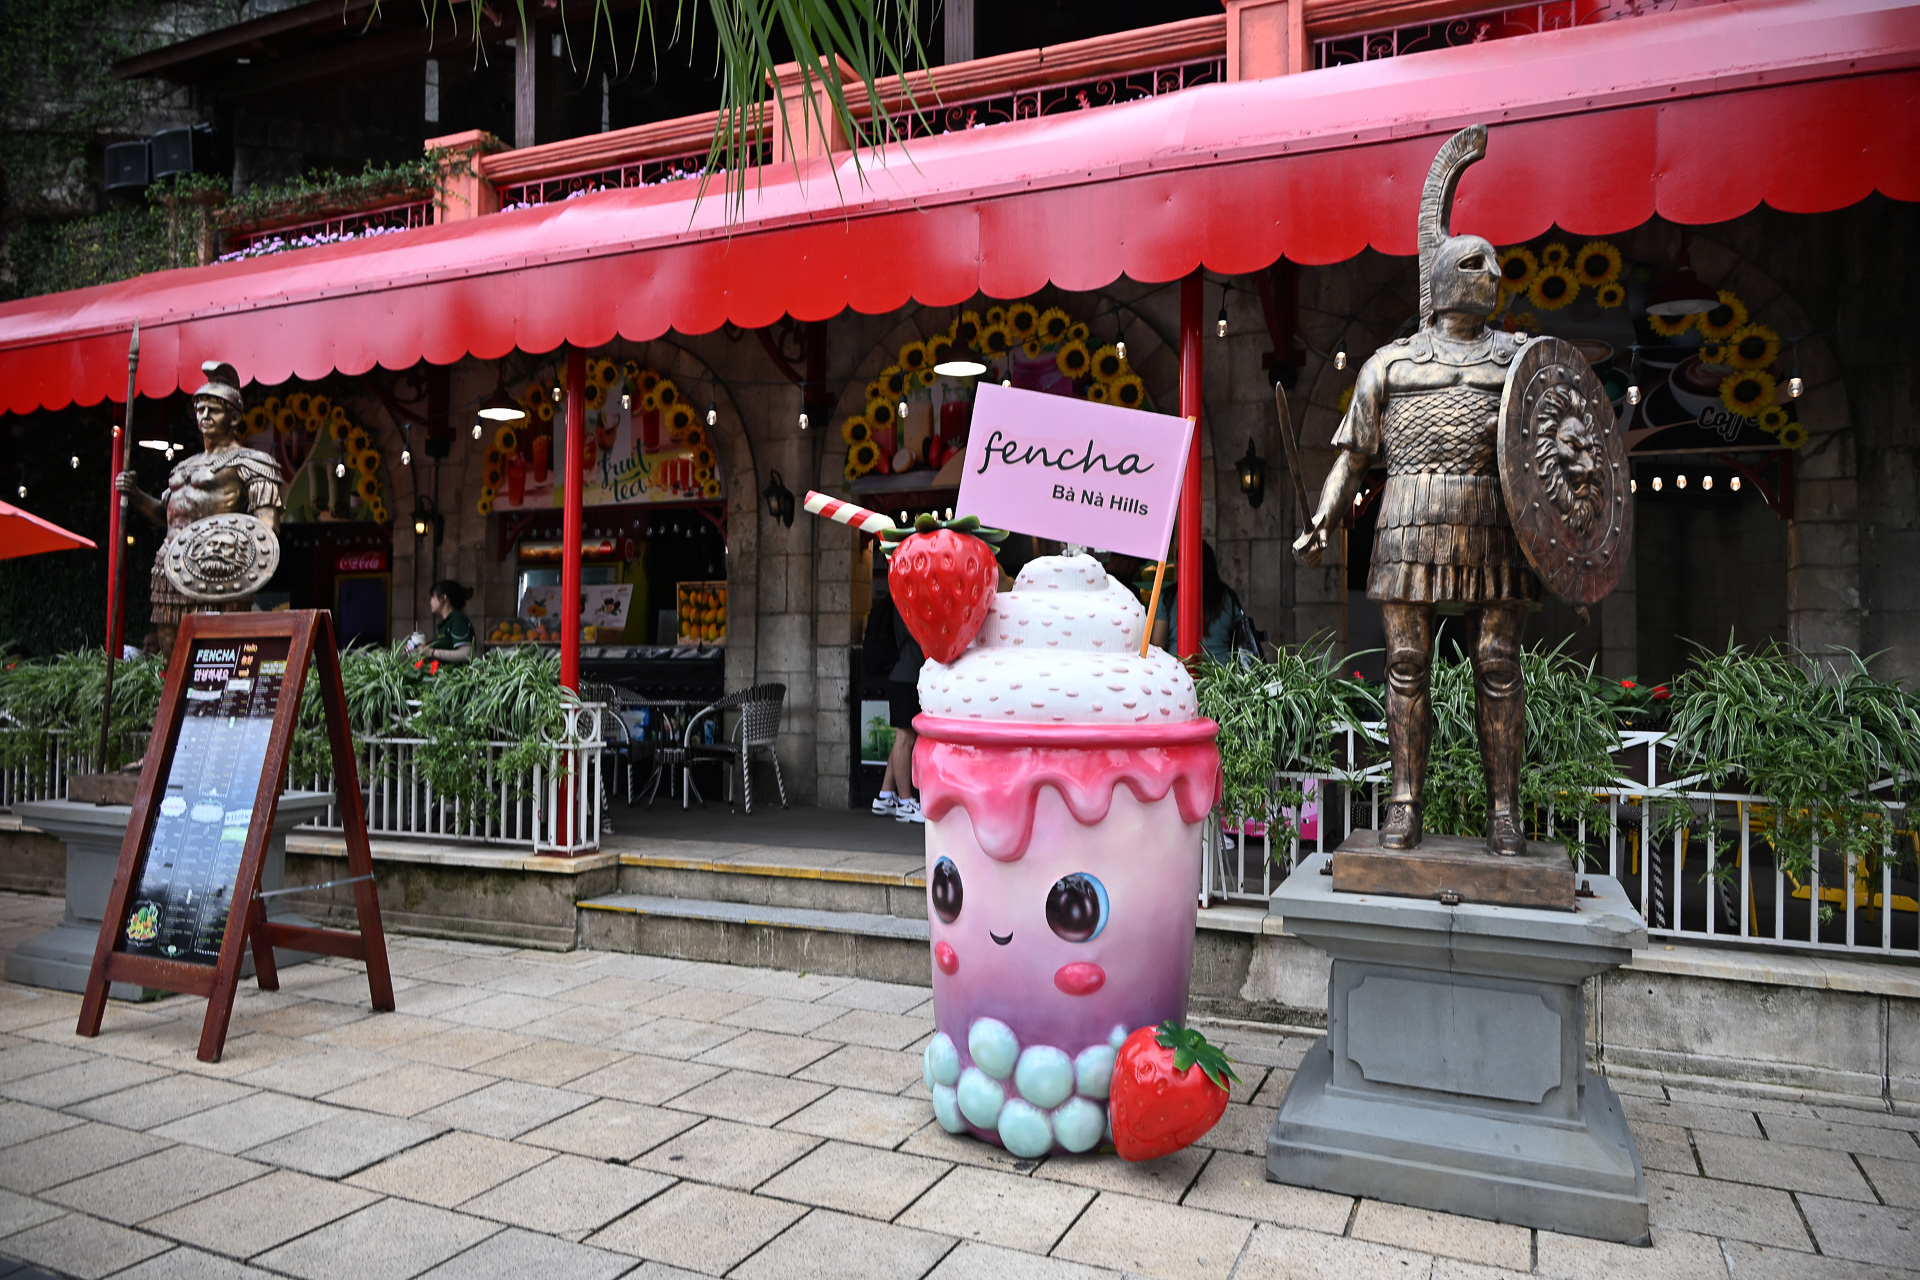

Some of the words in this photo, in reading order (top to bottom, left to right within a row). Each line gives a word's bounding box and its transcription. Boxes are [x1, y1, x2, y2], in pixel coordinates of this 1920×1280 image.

[597, 438, 651, 489] fruit
[977, 431, 1154, 475] fencha
[609, 478, 647, 502] tea
[1052, 484, 1075, 502] Bà
[1080, 489, 1103, 507] Nà
[1109, 495, 1149, 515] Hills
[196, 649, 235, 662] FENCHA
